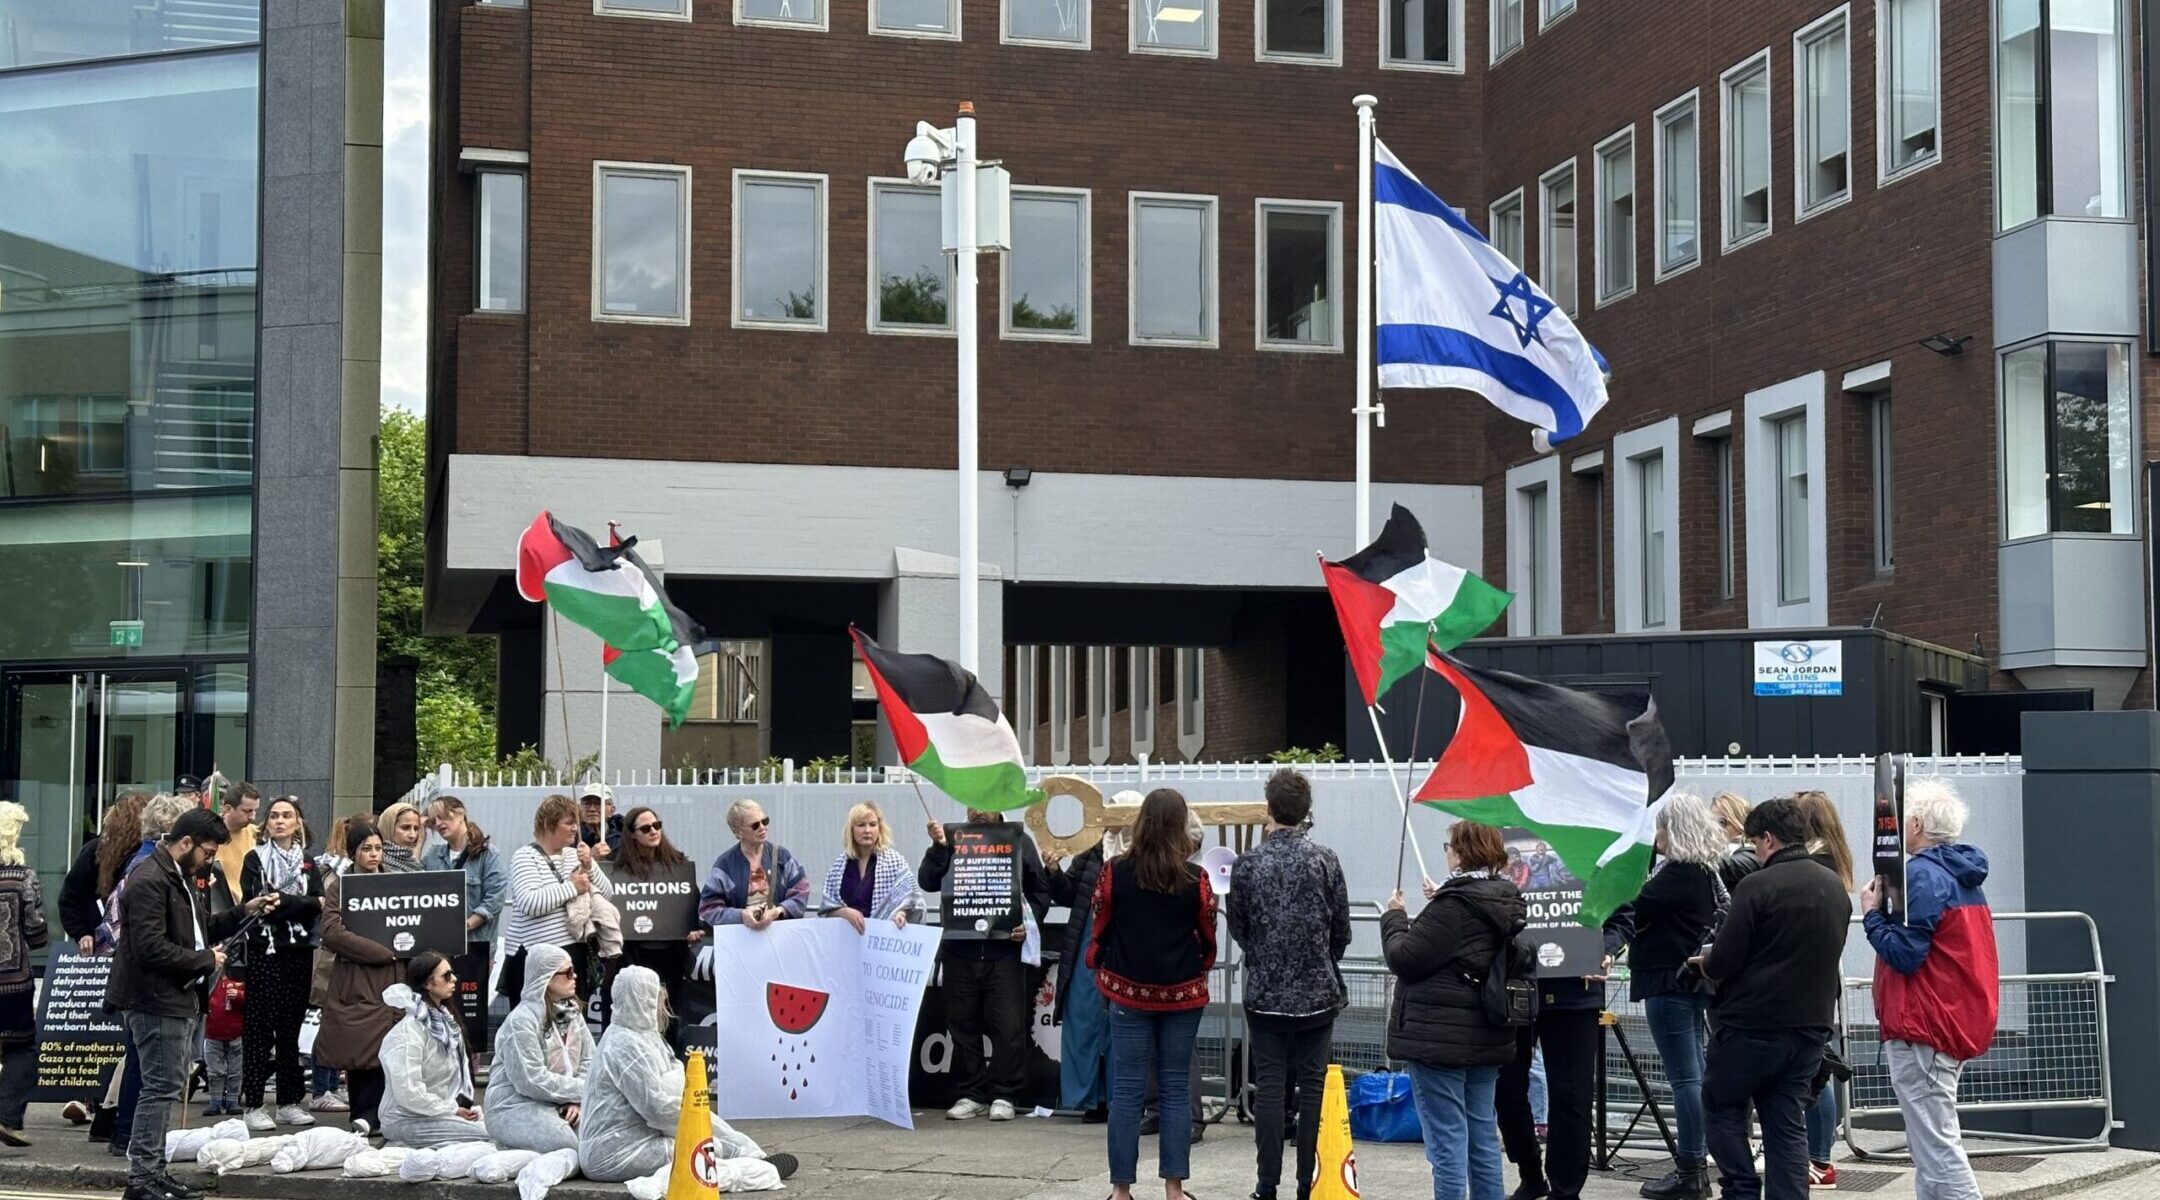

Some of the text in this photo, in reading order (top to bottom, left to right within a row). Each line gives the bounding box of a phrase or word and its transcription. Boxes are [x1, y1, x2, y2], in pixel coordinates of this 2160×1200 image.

[1758, 666, 1837, 674] SEAN JORDAN
[972, 844, 1013, 854] YEARS
[966, 857, 1012, 865] SUFFERING
[614, 881, 692, 895] NCTIONS
[1560, 890, 1583, 899] THE
[347, 893, 460, 912] SANCTIONS
[626, 900, 658, 911] NOW
[972, 897, 994, 905] HOPE
[953, 907, 1011, 916] HUMANITY
[385, 914, 422, 927] NOW
[867, 935, 923, 957] FREEDOM
[58, 954, 96, 963] Mothers
[862, 961, 872, 977] TO
[875, 964, 924, 985] COMMIT
[50, 987, 106, 999] they cannot
[48, 999, 87, 1010] produce
[864, 990, 911, 1012] GENOCIDE
[46, 1009, 91, 1020] feed their
[44, 1021, 123, 1031] newborn babies.
[40, 1041, 126, 1052] 80% of mothers in
[38, 1053, 64, 1063] Gaza
[65, 1055, 82, 1063] are
[66, 1066, 77, 1074] to
[79, 1065, 100, 1075] feed
[38, 1076, 101, 1086] heir children.
